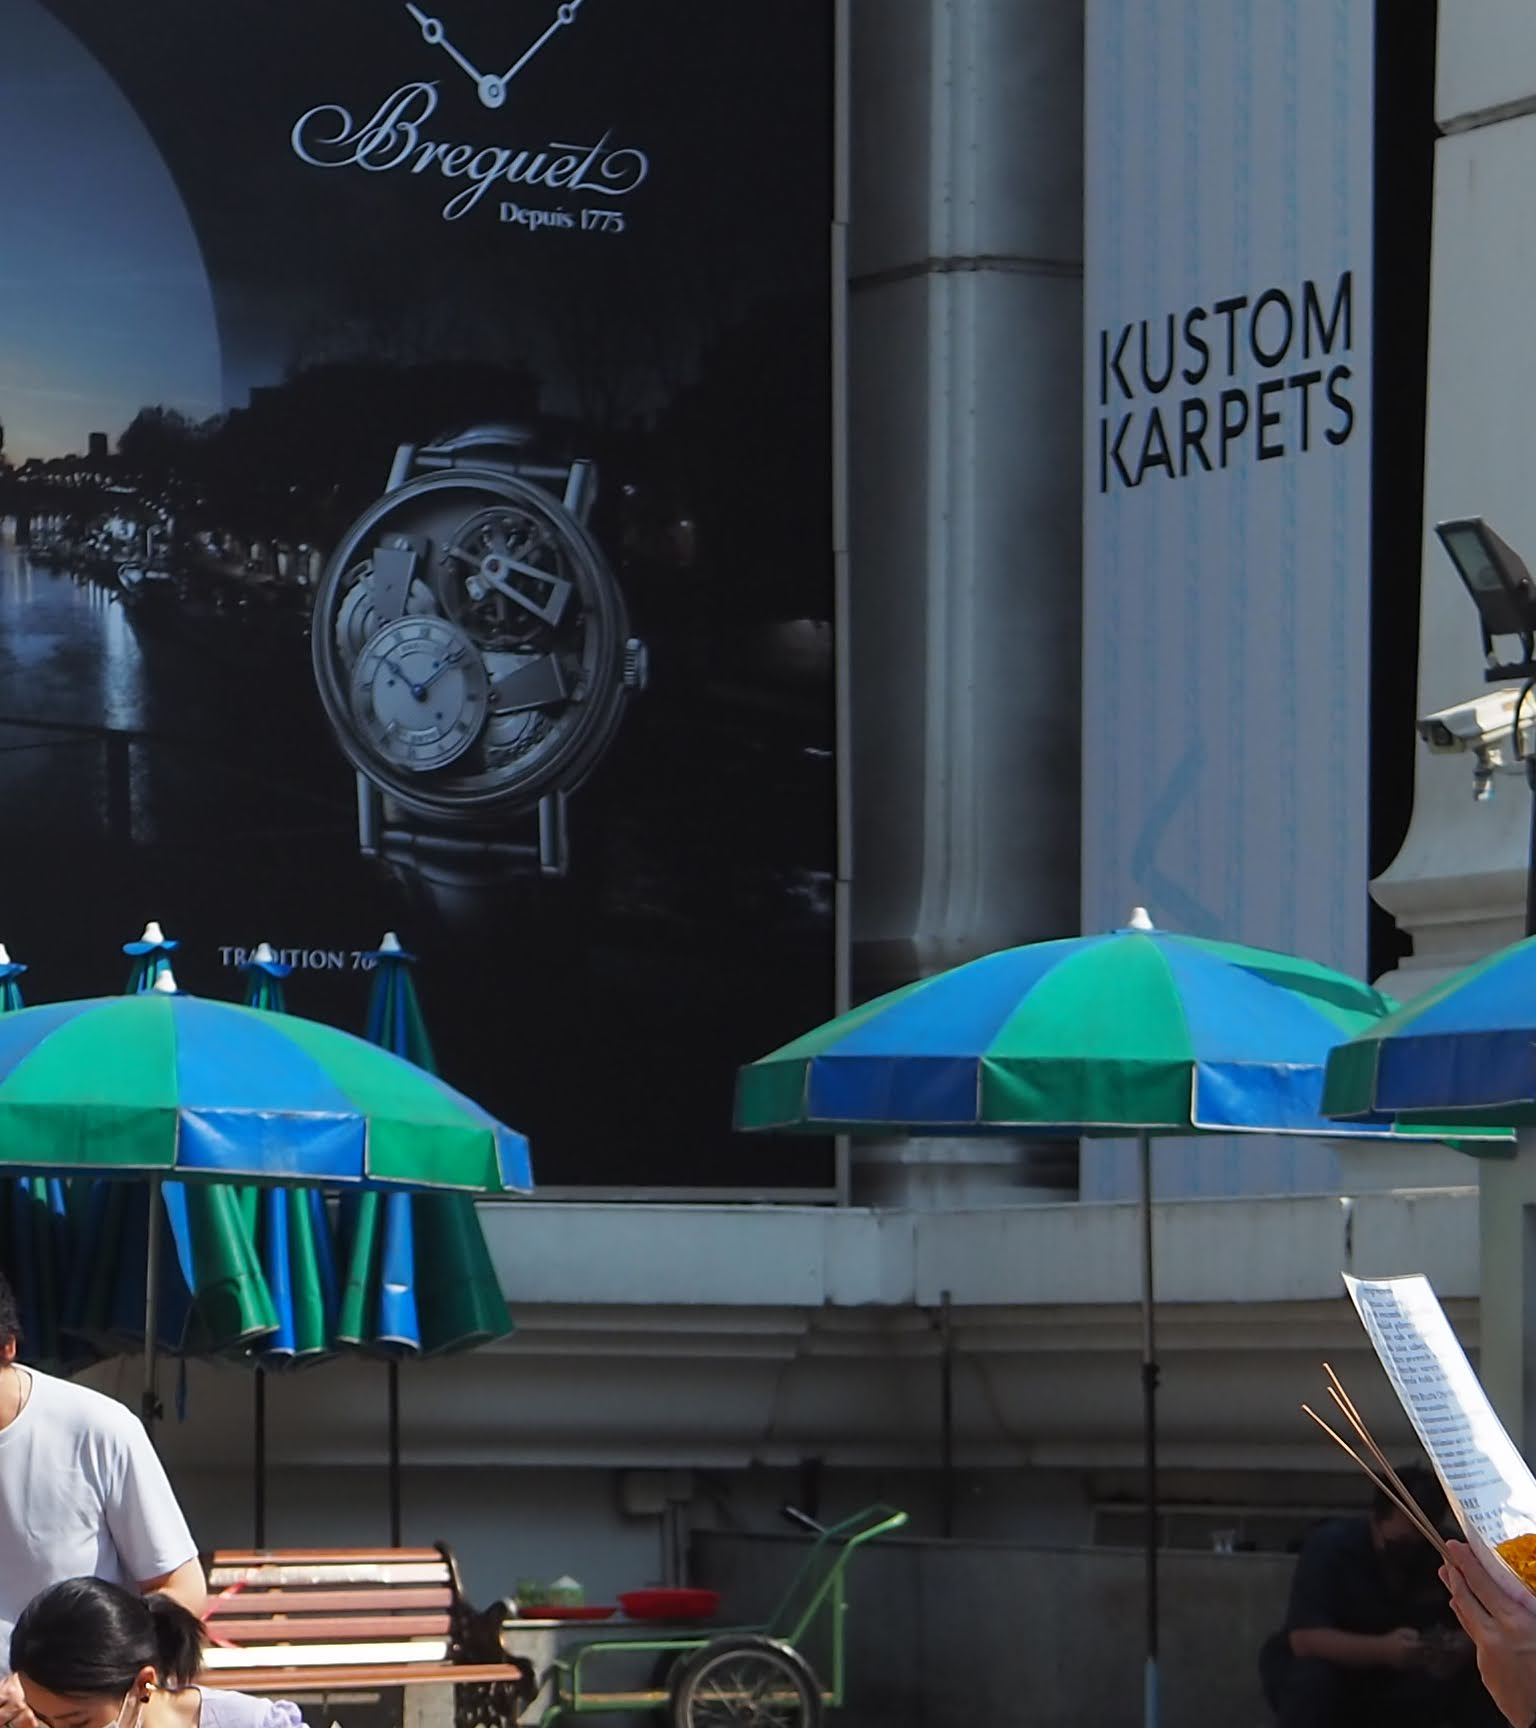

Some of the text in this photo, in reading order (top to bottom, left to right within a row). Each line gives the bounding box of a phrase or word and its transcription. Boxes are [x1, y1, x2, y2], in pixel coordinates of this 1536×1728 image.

[291, 80, 649, 220] Breguet
[499, 202, 626, 233] Depuis 1775
[1100, 270, 1353, 406] KUSTOM
[1100, 363, 1354, 493] KARPETS
